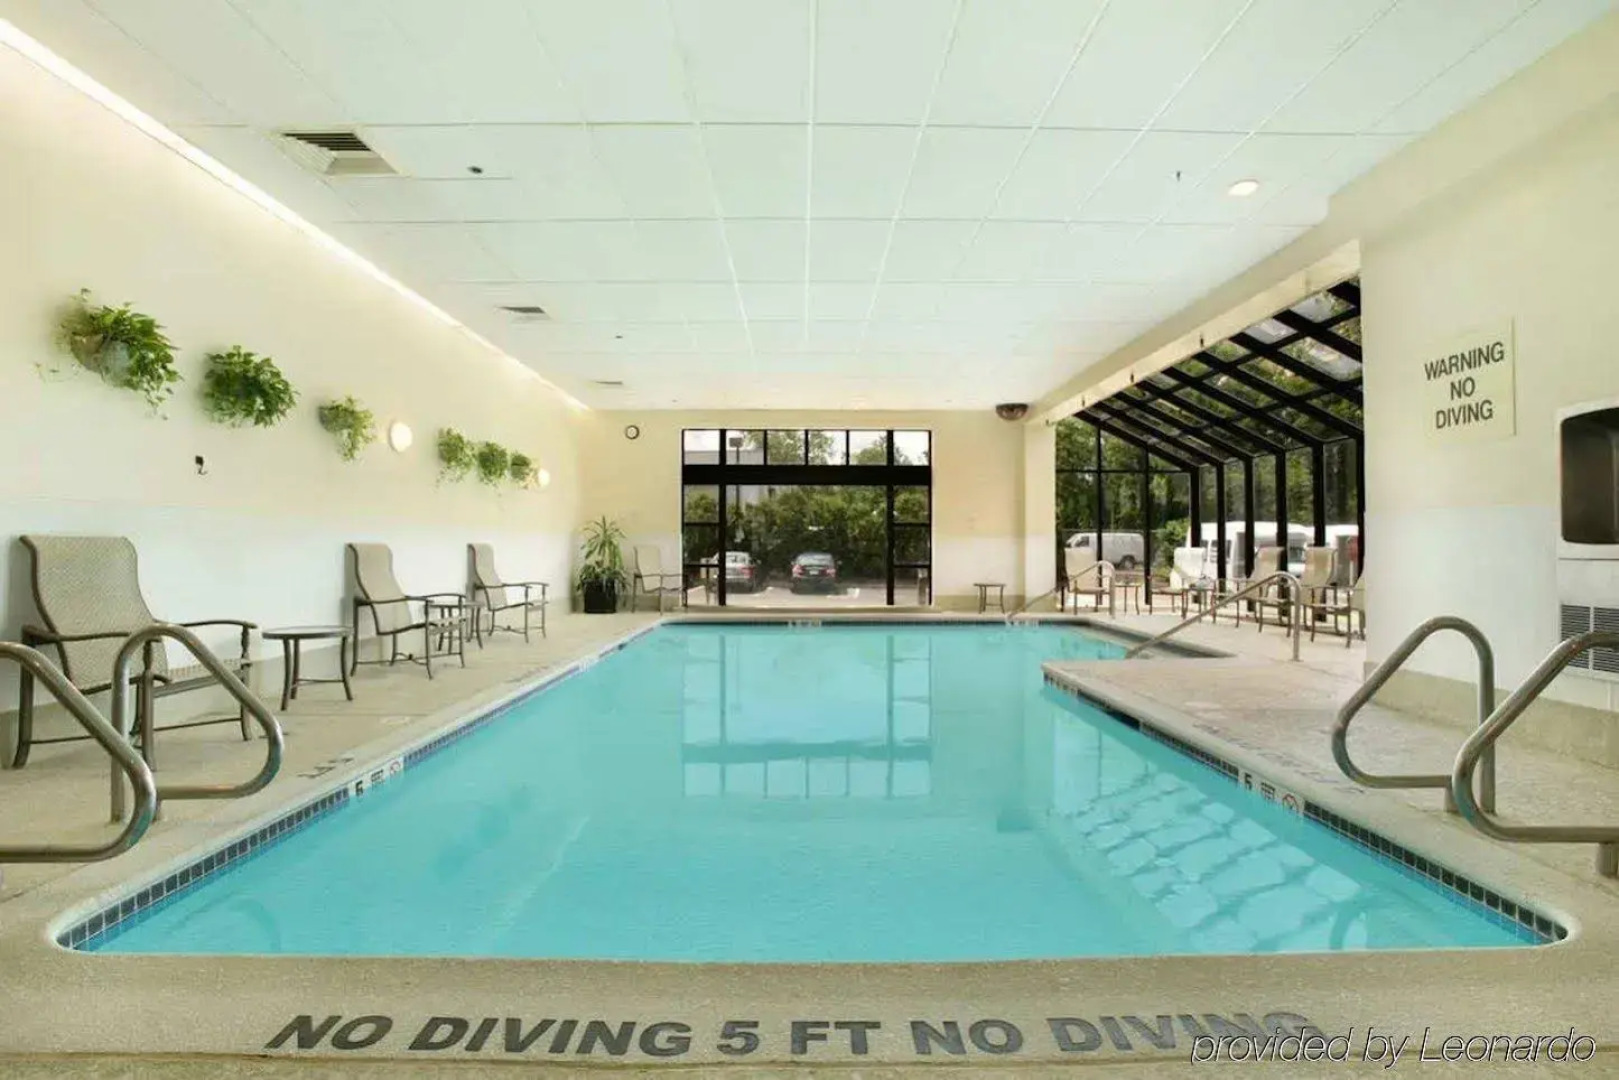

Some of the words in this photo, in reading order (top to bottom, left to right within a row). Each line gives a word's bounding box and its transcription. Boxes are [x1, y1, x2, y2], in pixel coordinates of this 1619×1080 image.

[1424, 341, 1505, 381] WARNING
[1450, 376, 1476, 401] NO
[1436, 399, 1494, 429] DIVING
[265, 1015, 393, 1051] NO
[408, 1017, 692, 1056] DIVING
[716, 1021, 760, 1055] 5
[790, 1021, 881, 1055] FT
[910, 1019, 1023, 1055] NO
[1047, 1012, 1328, 1053] DIVING
